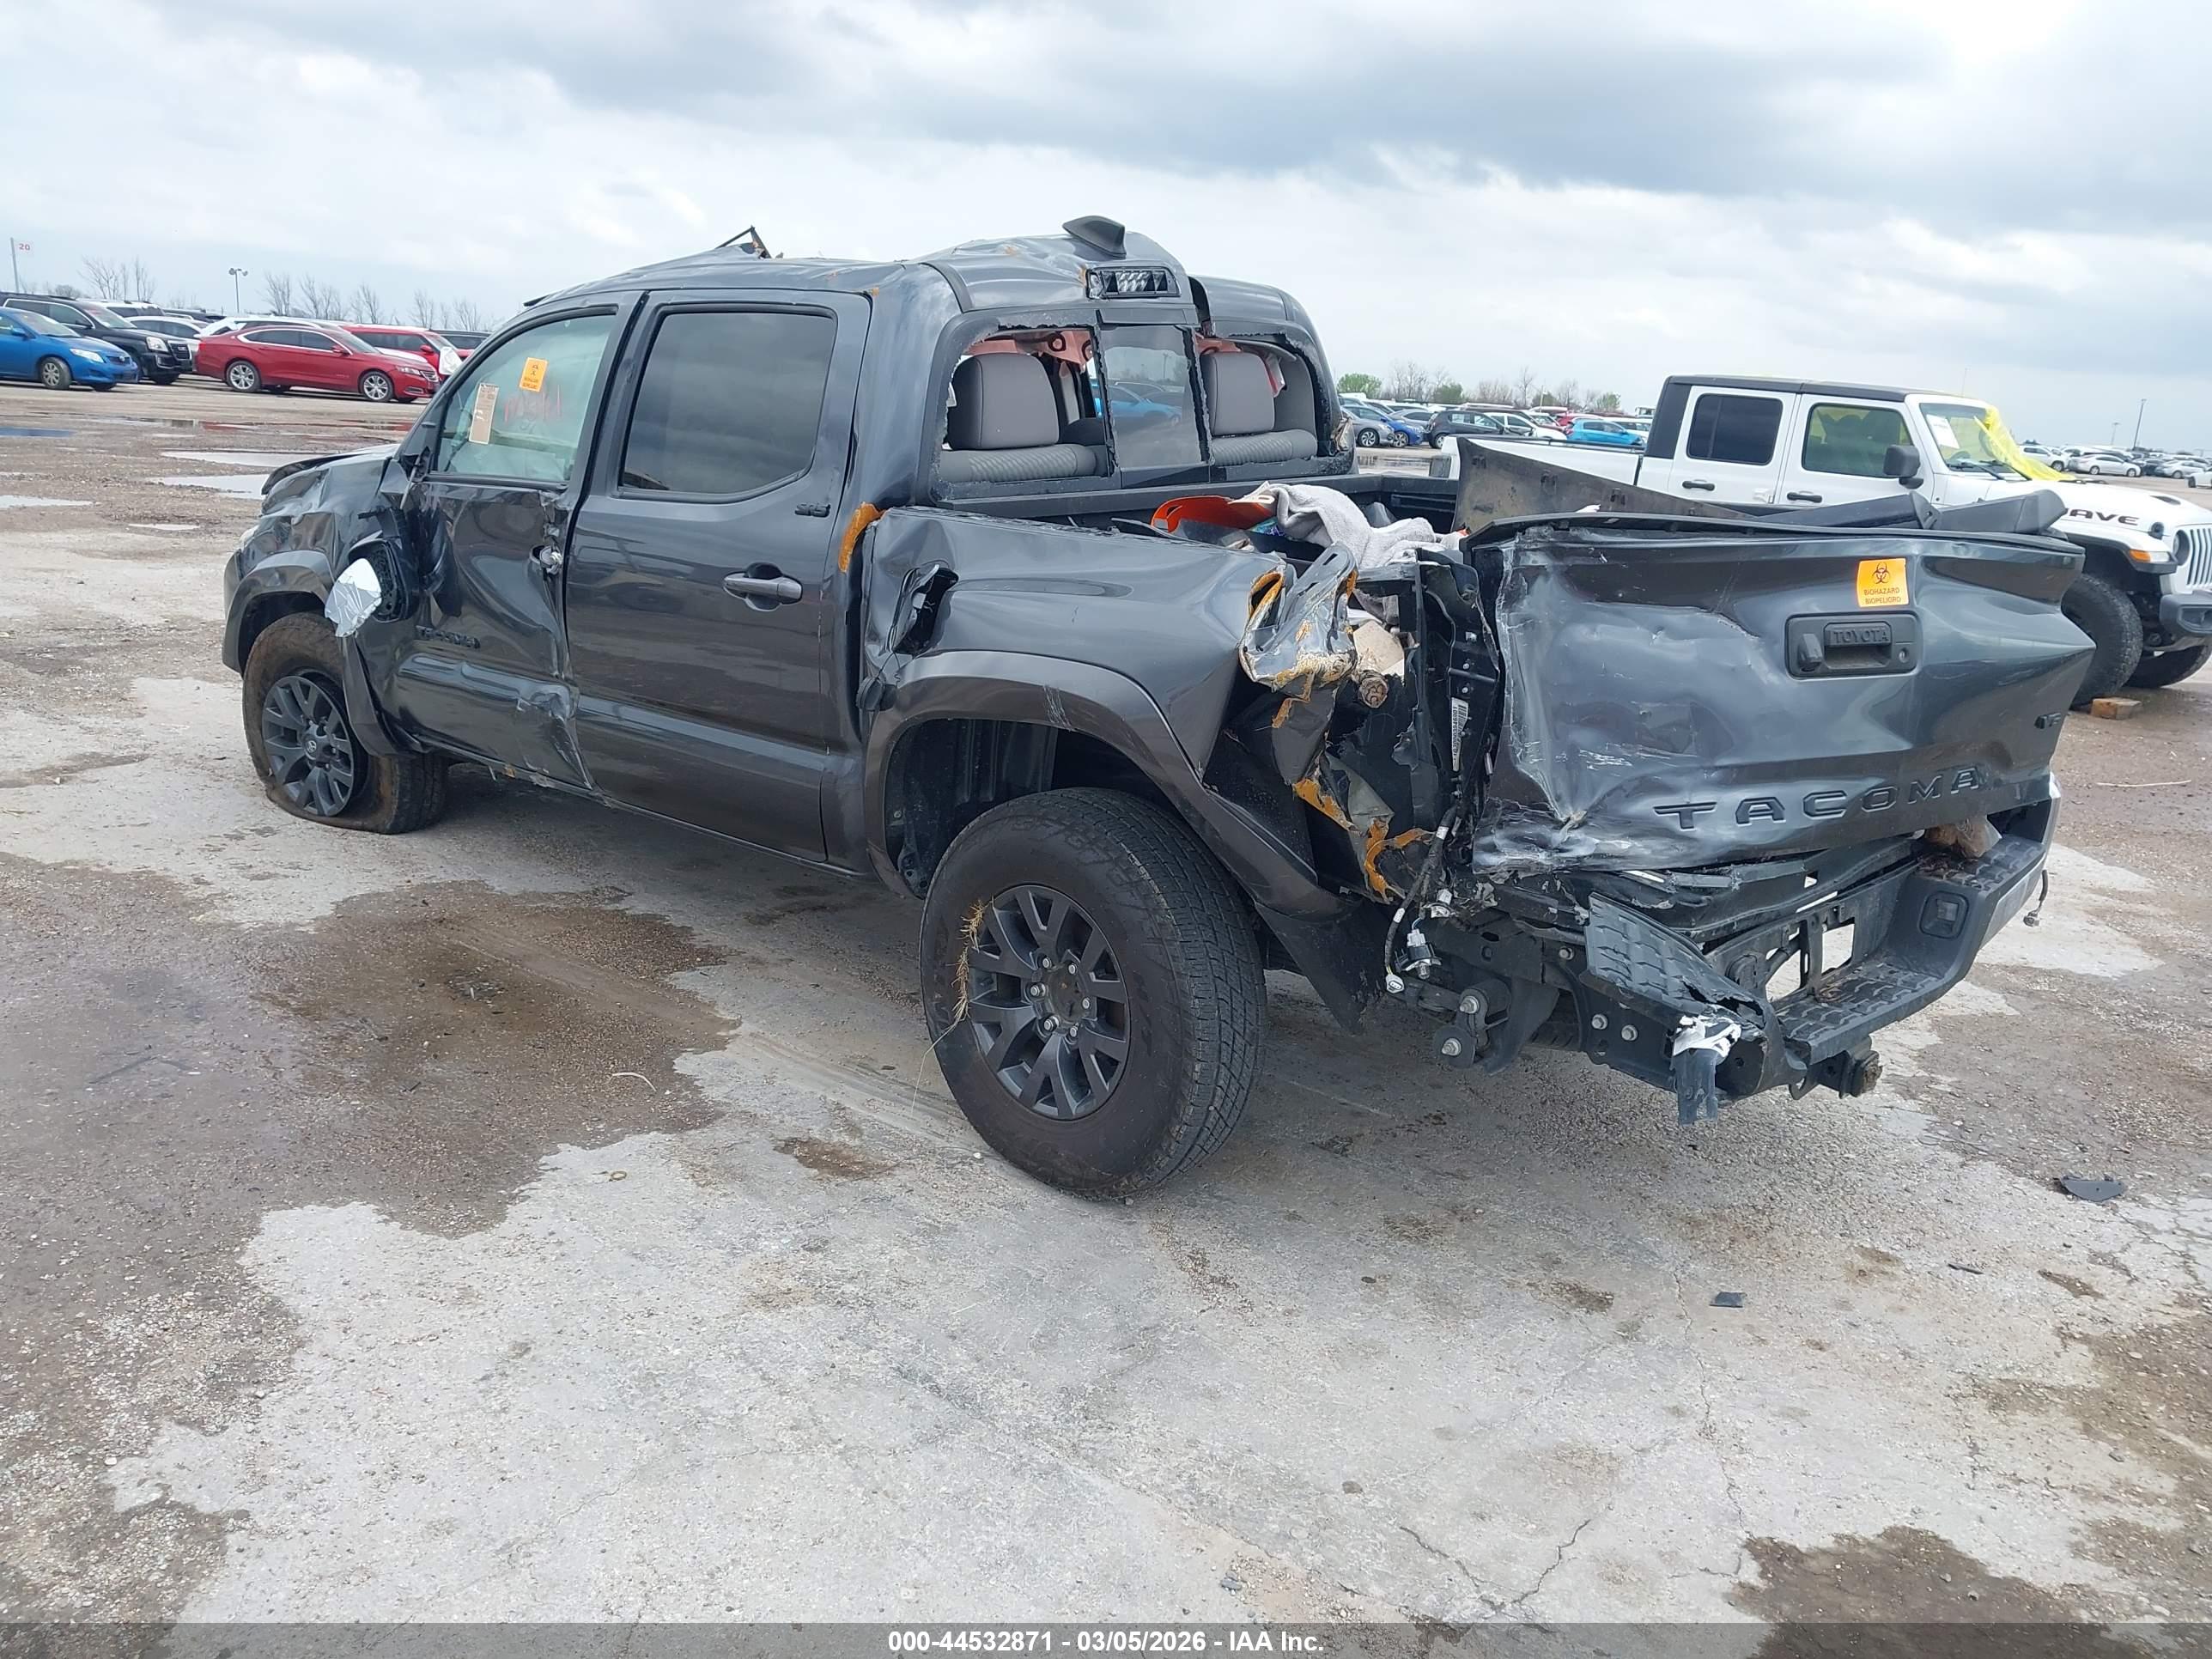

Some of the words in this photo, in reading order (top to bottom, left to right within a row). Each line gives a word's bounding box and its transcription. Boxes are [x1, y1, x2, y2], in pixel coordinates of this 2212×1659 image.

[1863, 587, 1900, 596] BIOHAZARD
[1864, 596, 1902, 605] BIOPELIGRO
[1833, 628, 1889, 643] TOYOTA
[1653, 767, 1987, 830] TACOMA
